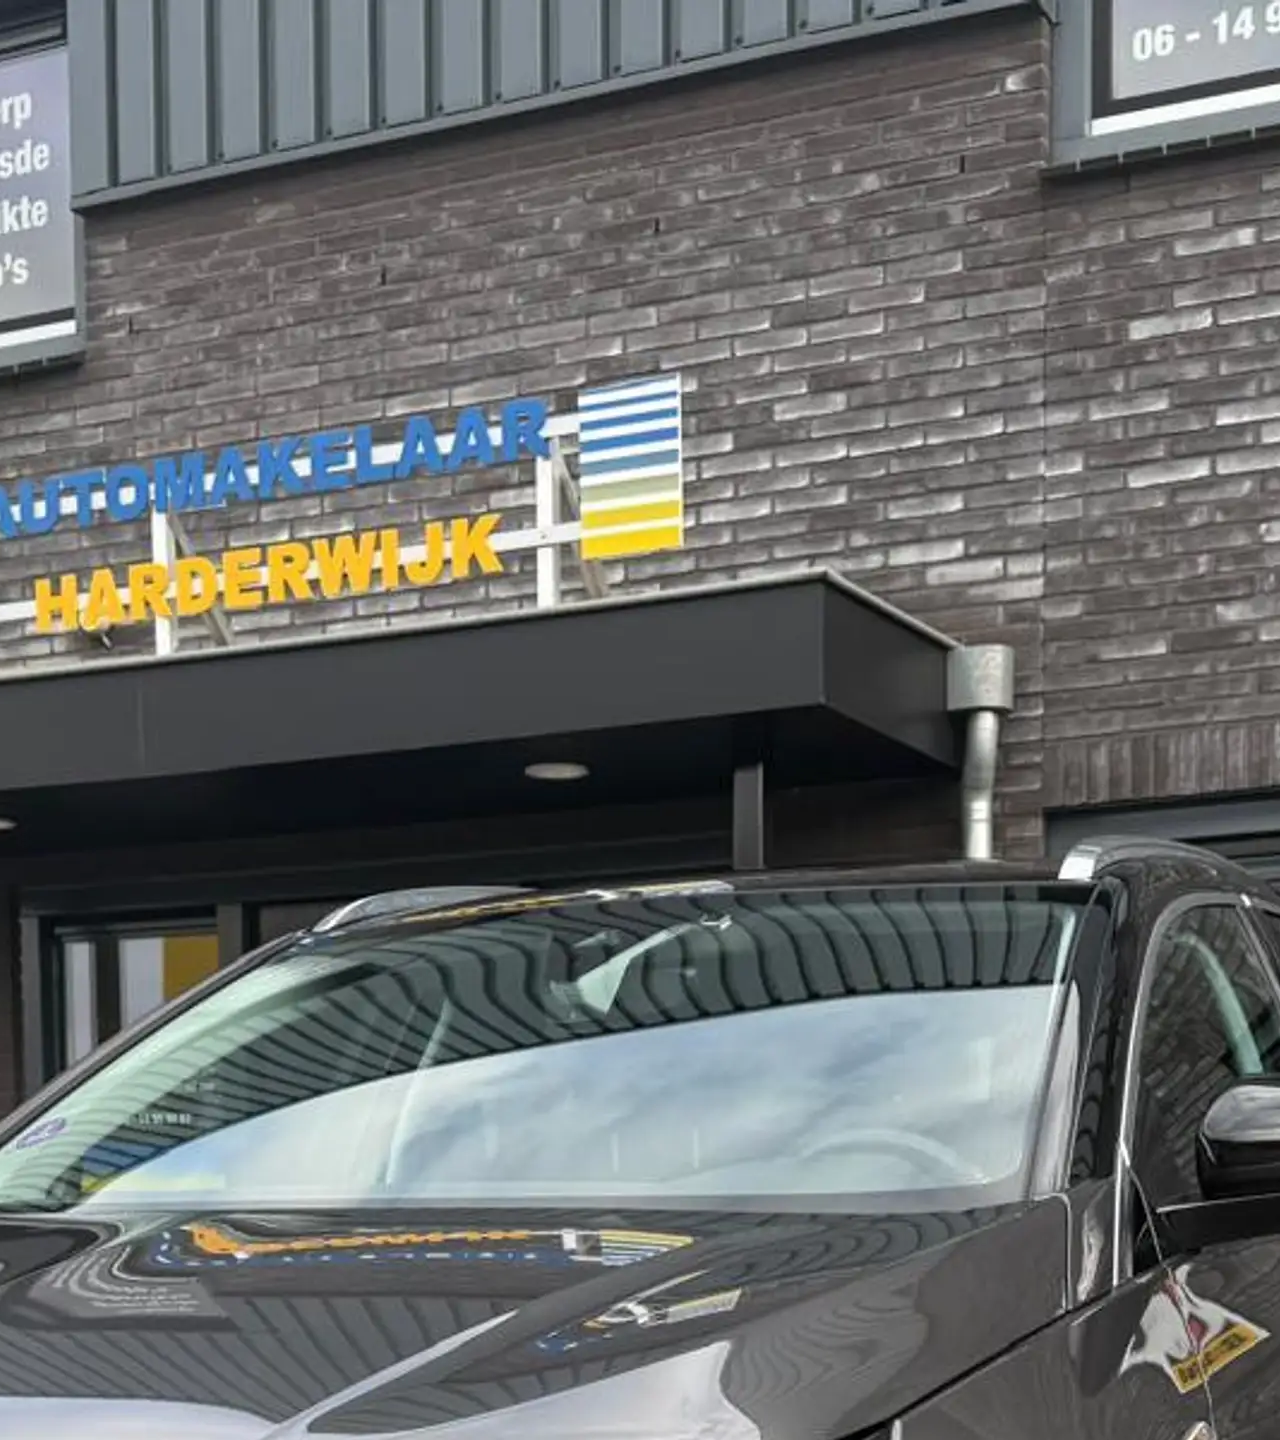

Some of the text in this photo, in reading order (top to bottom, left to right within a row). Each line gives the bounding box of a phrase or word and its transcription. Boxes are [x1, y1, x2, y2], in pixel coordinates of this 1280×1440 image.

[1131, 24, 1176, 61] 06
[1212, 7, 1256, 45] 14
[33, 514, 503, 633] HARDERWIJK
